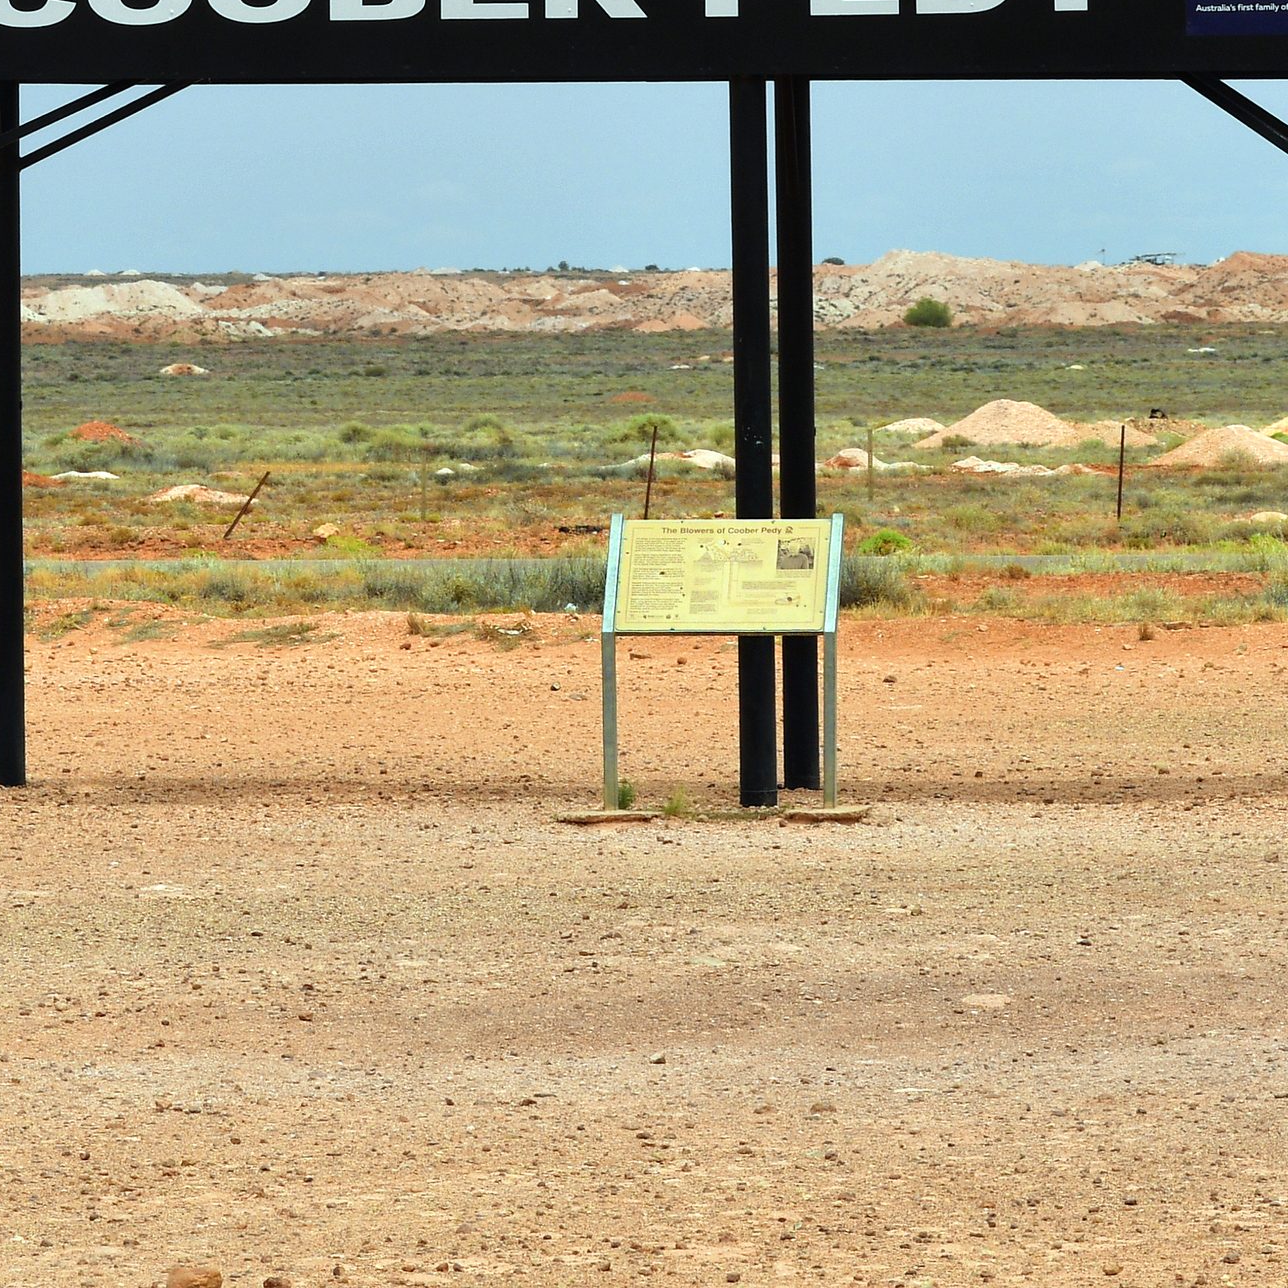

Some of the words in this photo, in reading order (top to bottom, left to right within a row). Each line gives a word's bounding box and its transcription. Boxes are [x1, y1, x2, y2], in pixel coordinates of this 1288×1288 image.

[1196, 4, 1236, 12] Australia's
[1238, 3, 1253, 11] first
[1256, 3, 1279, 12] family
[761, 526, 783, 535] Pedy
